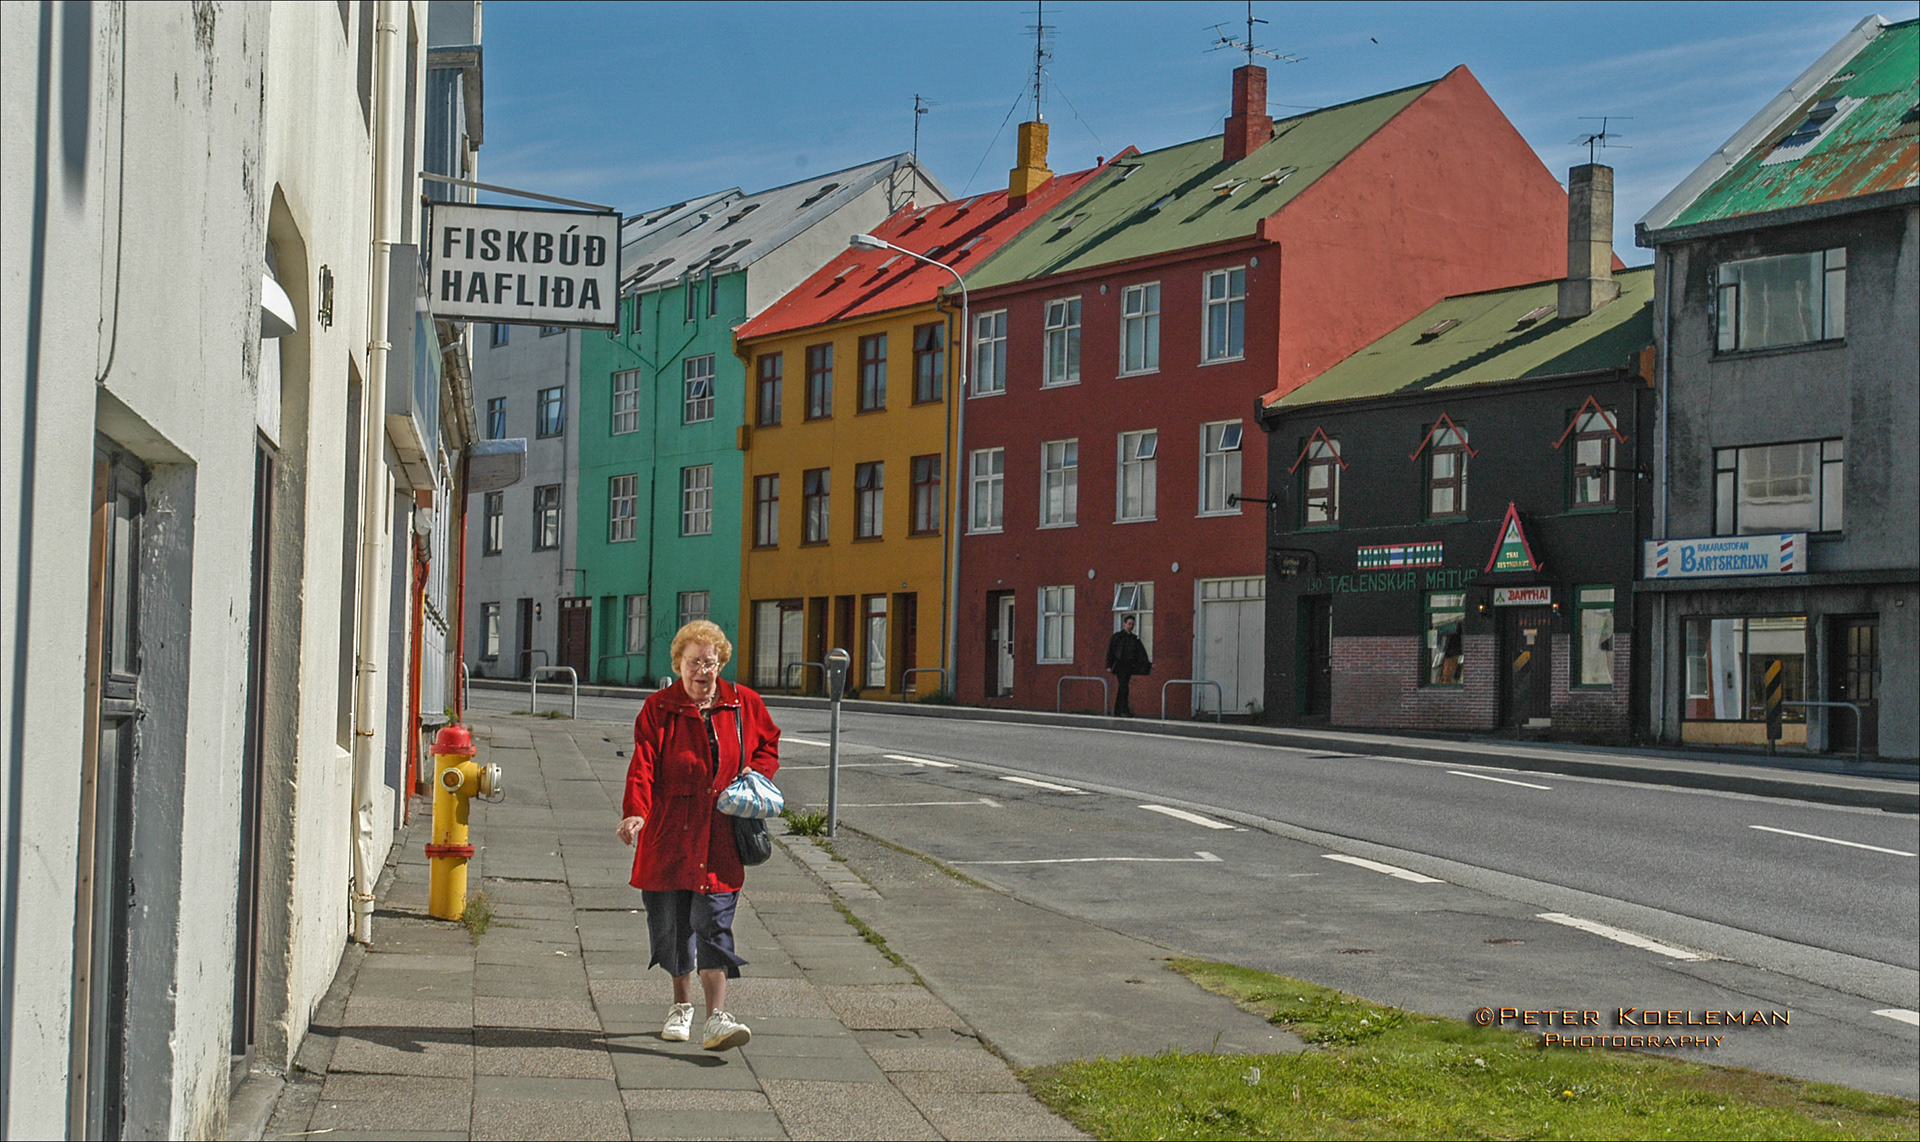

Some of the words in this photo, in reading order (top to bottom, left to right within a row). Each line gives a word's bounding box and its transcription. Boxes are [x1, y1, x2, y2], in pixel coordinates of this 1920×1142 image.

[442, 224, 606, 267] FISKBÚÐ
[441, 270, 601, 310] HAFLIÐA
[1399, 543, 1441, 567] THAI
[1680, 545, 1769, 573] BARTSKERINN
[1328, 571, 1417, 594] TÆLENSKUR
